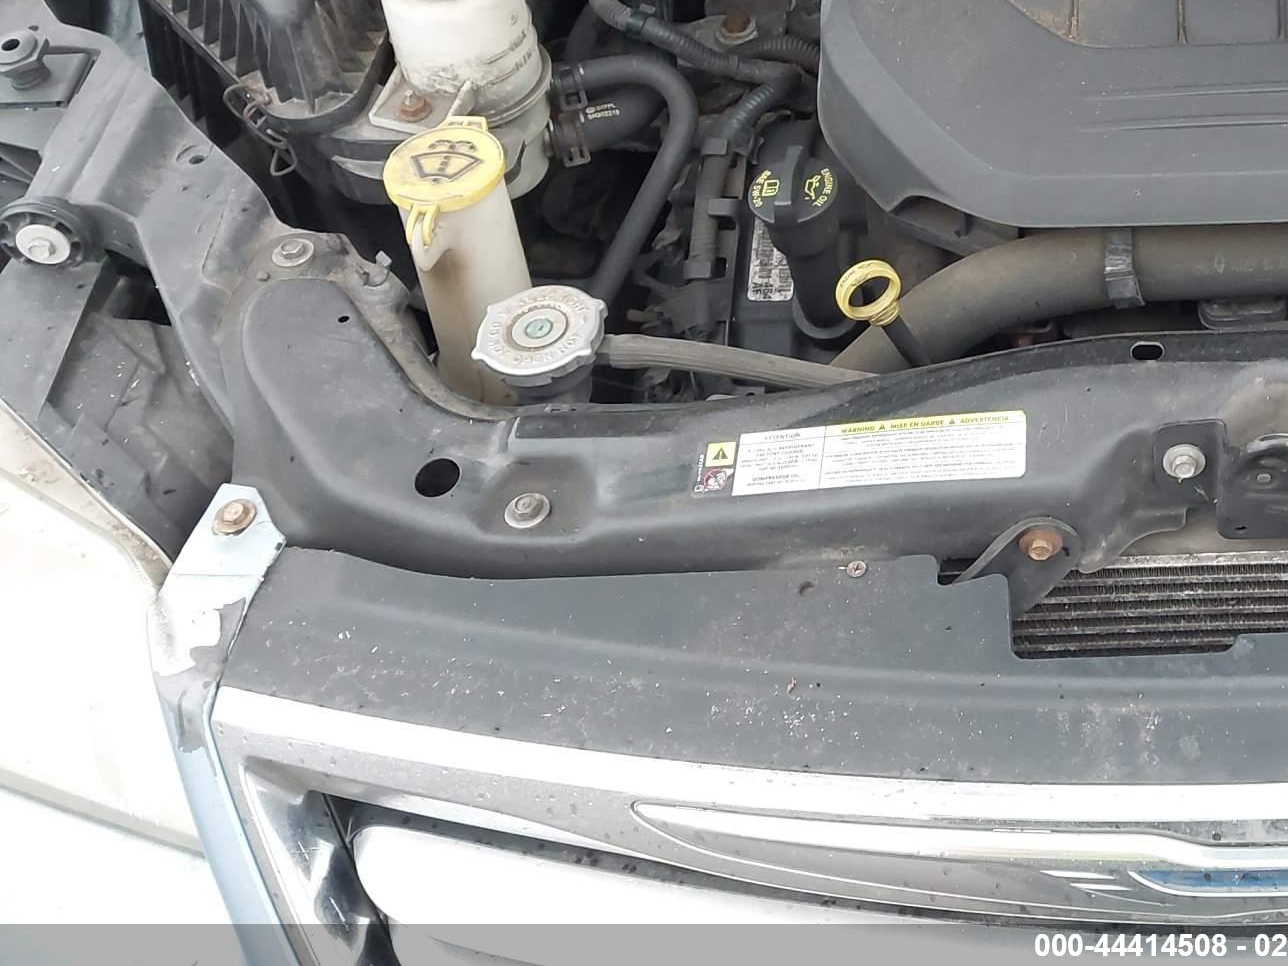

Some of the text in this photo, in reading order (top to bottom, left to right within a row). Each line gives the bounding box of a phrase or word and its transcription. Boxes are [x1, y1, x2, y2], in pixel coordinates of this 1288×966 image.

[812, 168, 833, 207] ENGINE OIL
[841, 425, 875, 434] WARNING
[960, 416, 1009, 424] ADVERTENCIA
